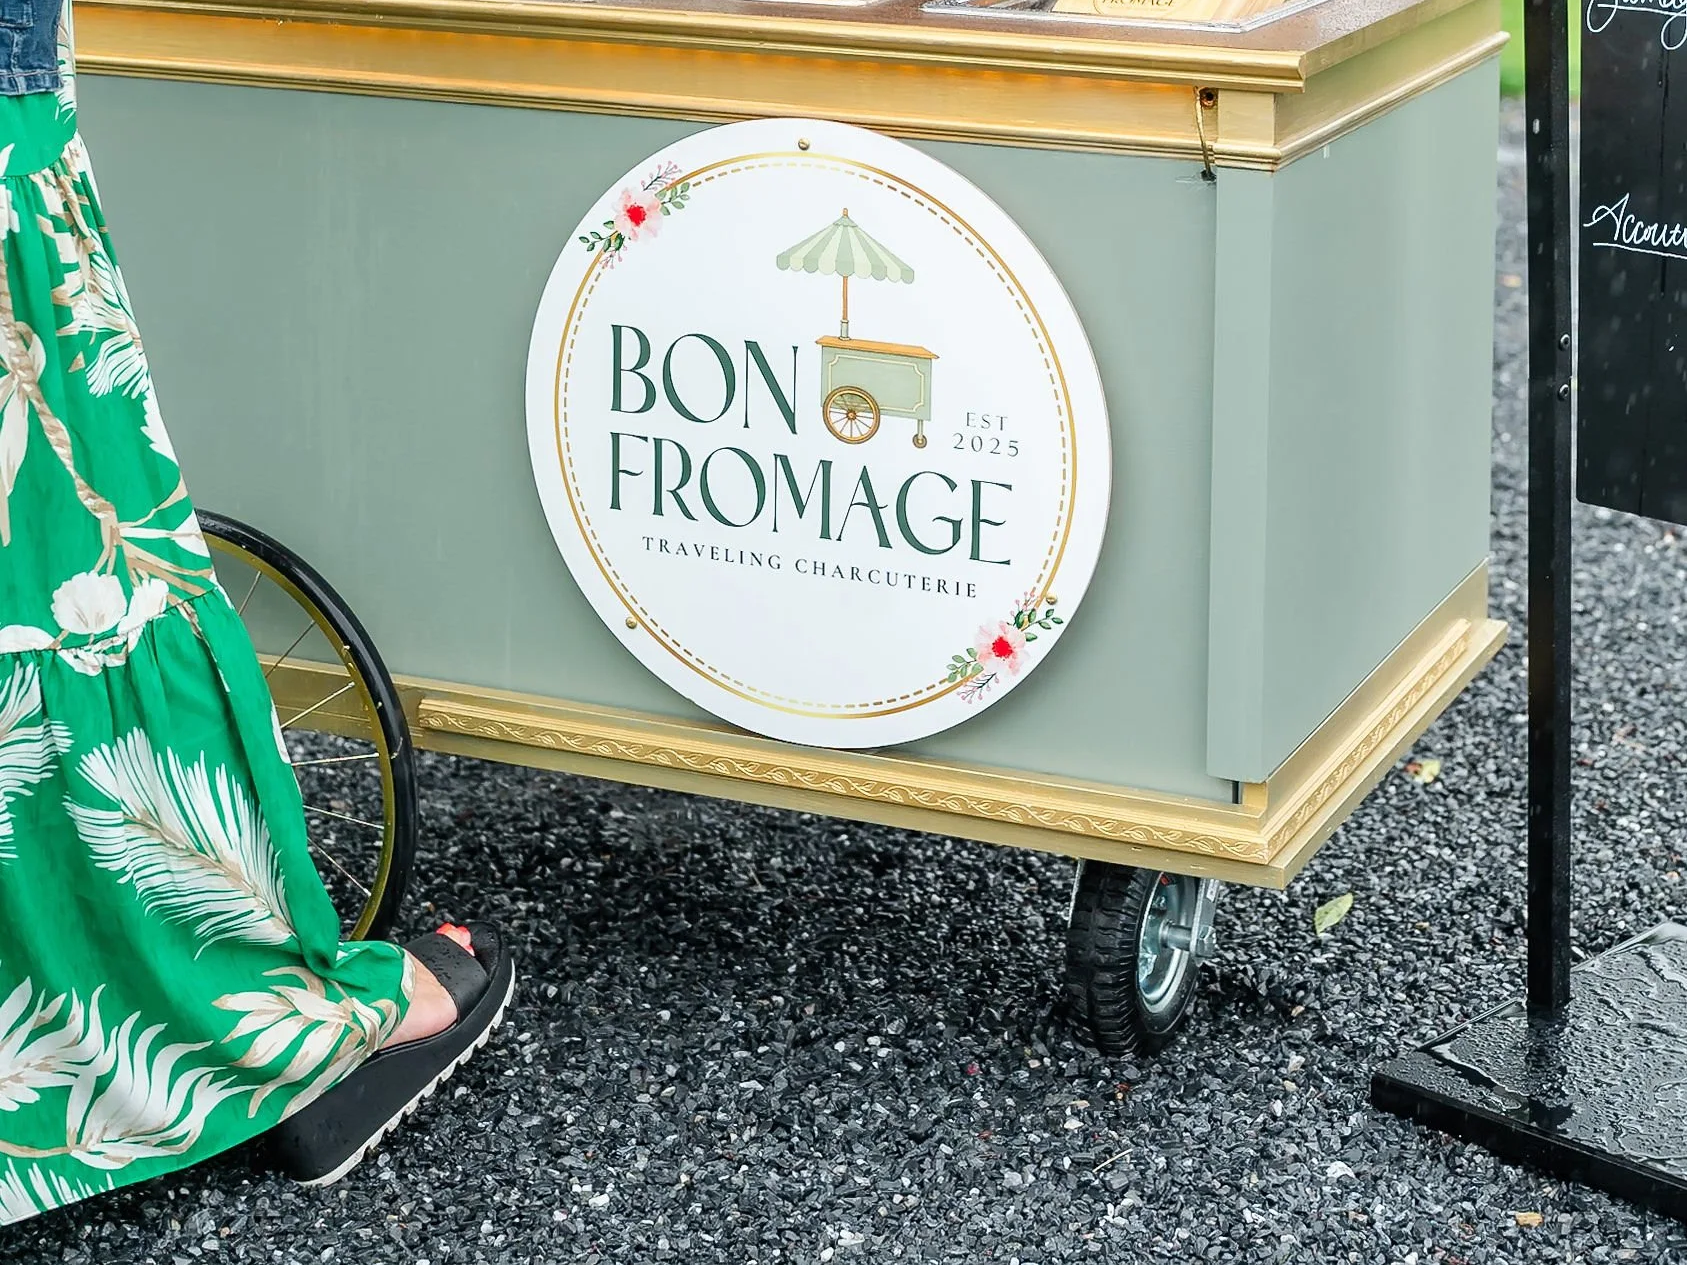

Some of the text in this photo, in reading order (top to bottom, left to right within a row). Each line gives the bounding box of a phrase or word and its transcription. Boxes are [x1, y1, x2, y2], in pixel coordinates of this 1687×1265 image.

[609, 323, 799, 435] BON
[952, 432, 1020, 458] 2025
[965, 411, 1009, 432] EST
[608, 431, 1014, 566] FROMAGE
[642, 535, 978, 599] TRAVELING CHARCUTERIE
